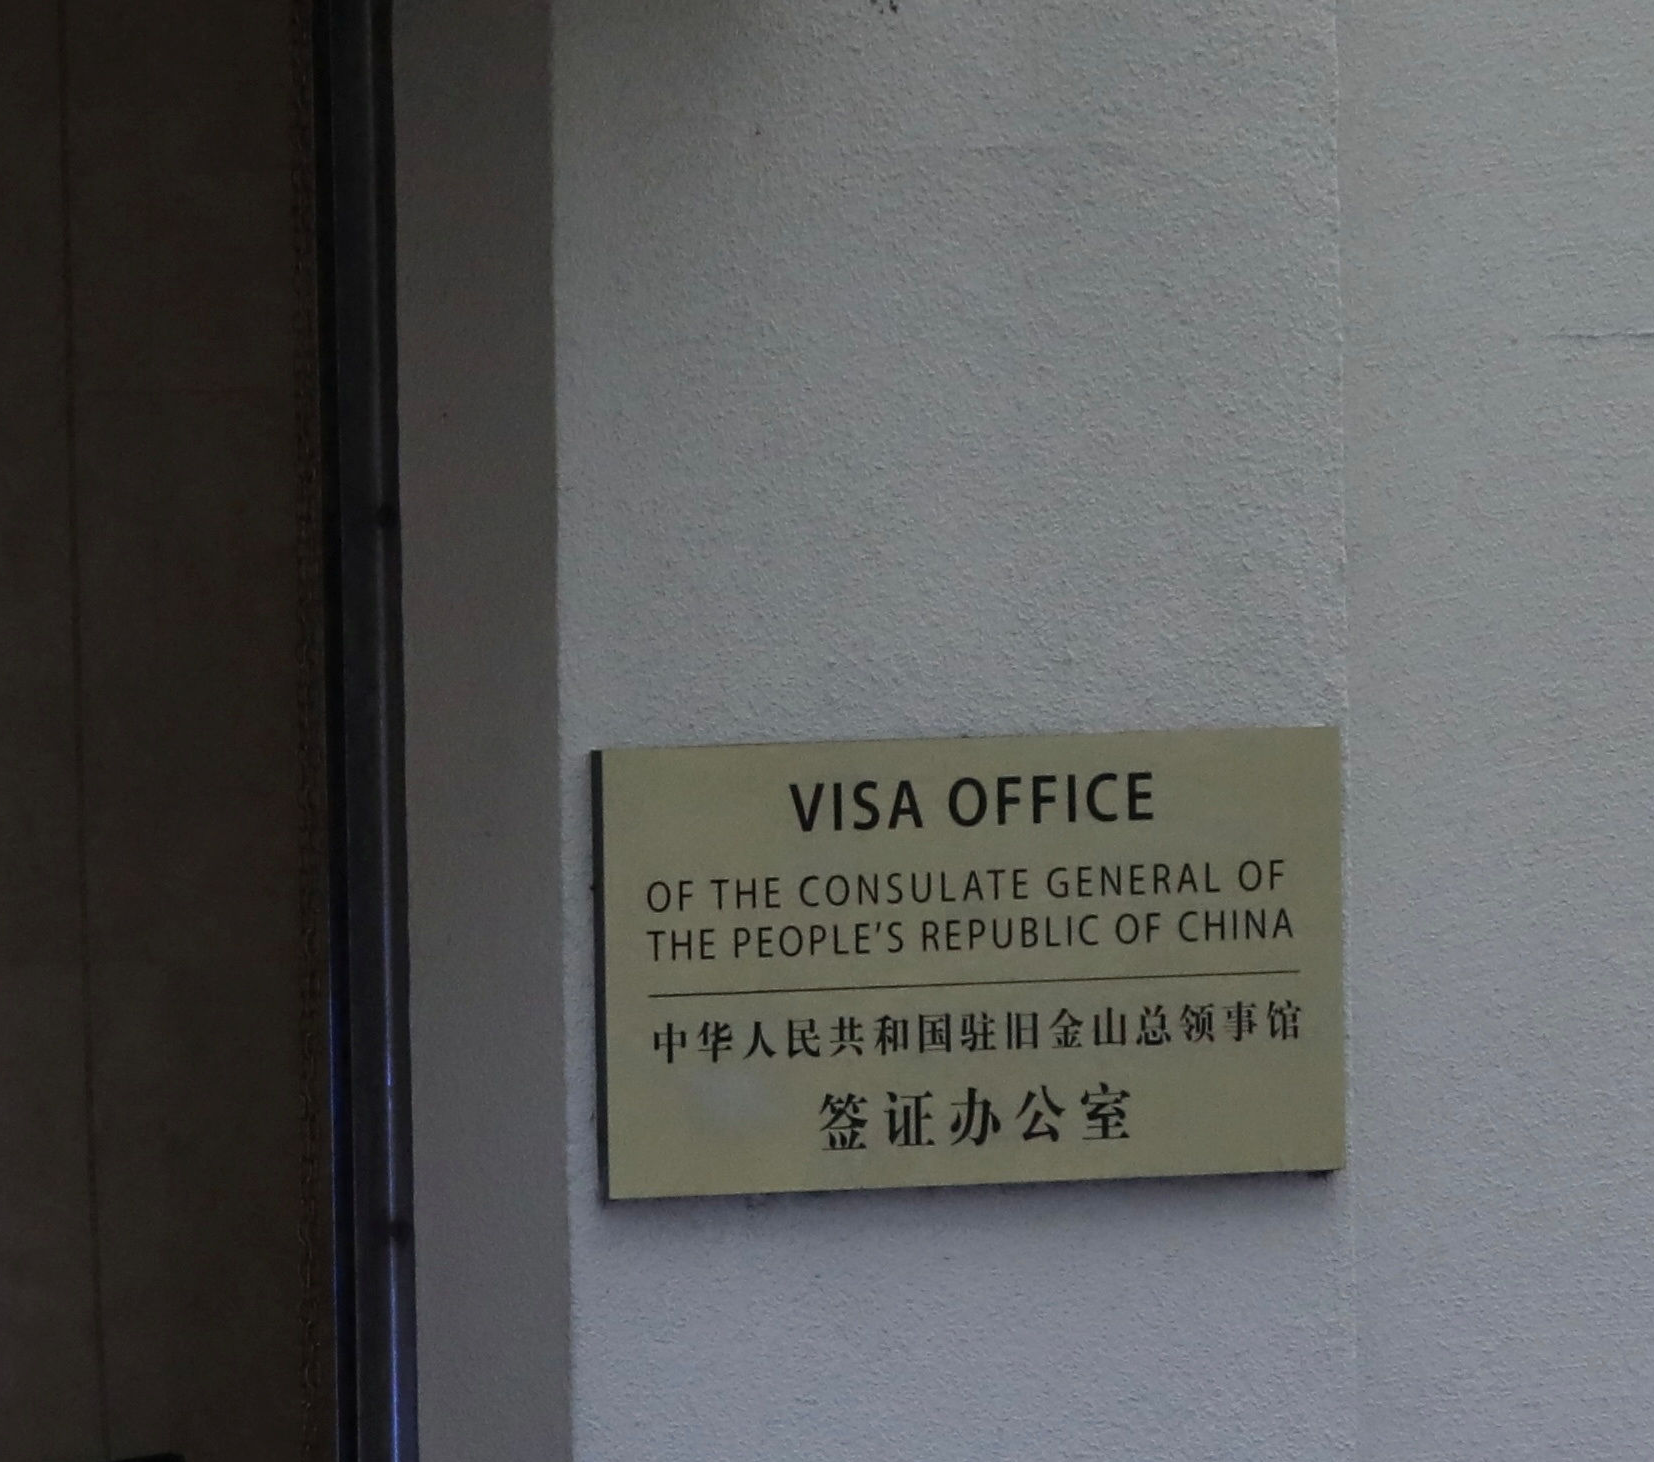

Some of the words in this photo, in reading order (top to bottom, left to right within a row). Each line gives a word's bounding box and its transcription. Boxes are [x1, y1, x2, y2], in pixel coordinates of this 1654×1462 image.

[789, 778, 924, 833] VISA
[948, 771, 1156, 825] OFFICE
[646, 879, 694, 914] OF
[710, 875, 780, 912] THE
[800, 867, 1029, 909] CONSULATE
[1047, 861, 1221, 899] GENERAL
[1238, 858, 1286, 894] OF
[646, 927, 715, 963] THE
[733, 921, 905, 959] PEOPLE'S
[921, 914, 1100, 952] REPUBLIC
[1116, 911, 1163, 947] OF
[1178, 906, 1294, 943] CHINA
[652, 1001, 1303, 1065] 中华人民共和国驻旧金山总领事馆
[820, 1082, 1132, 1152] 签证办公室
